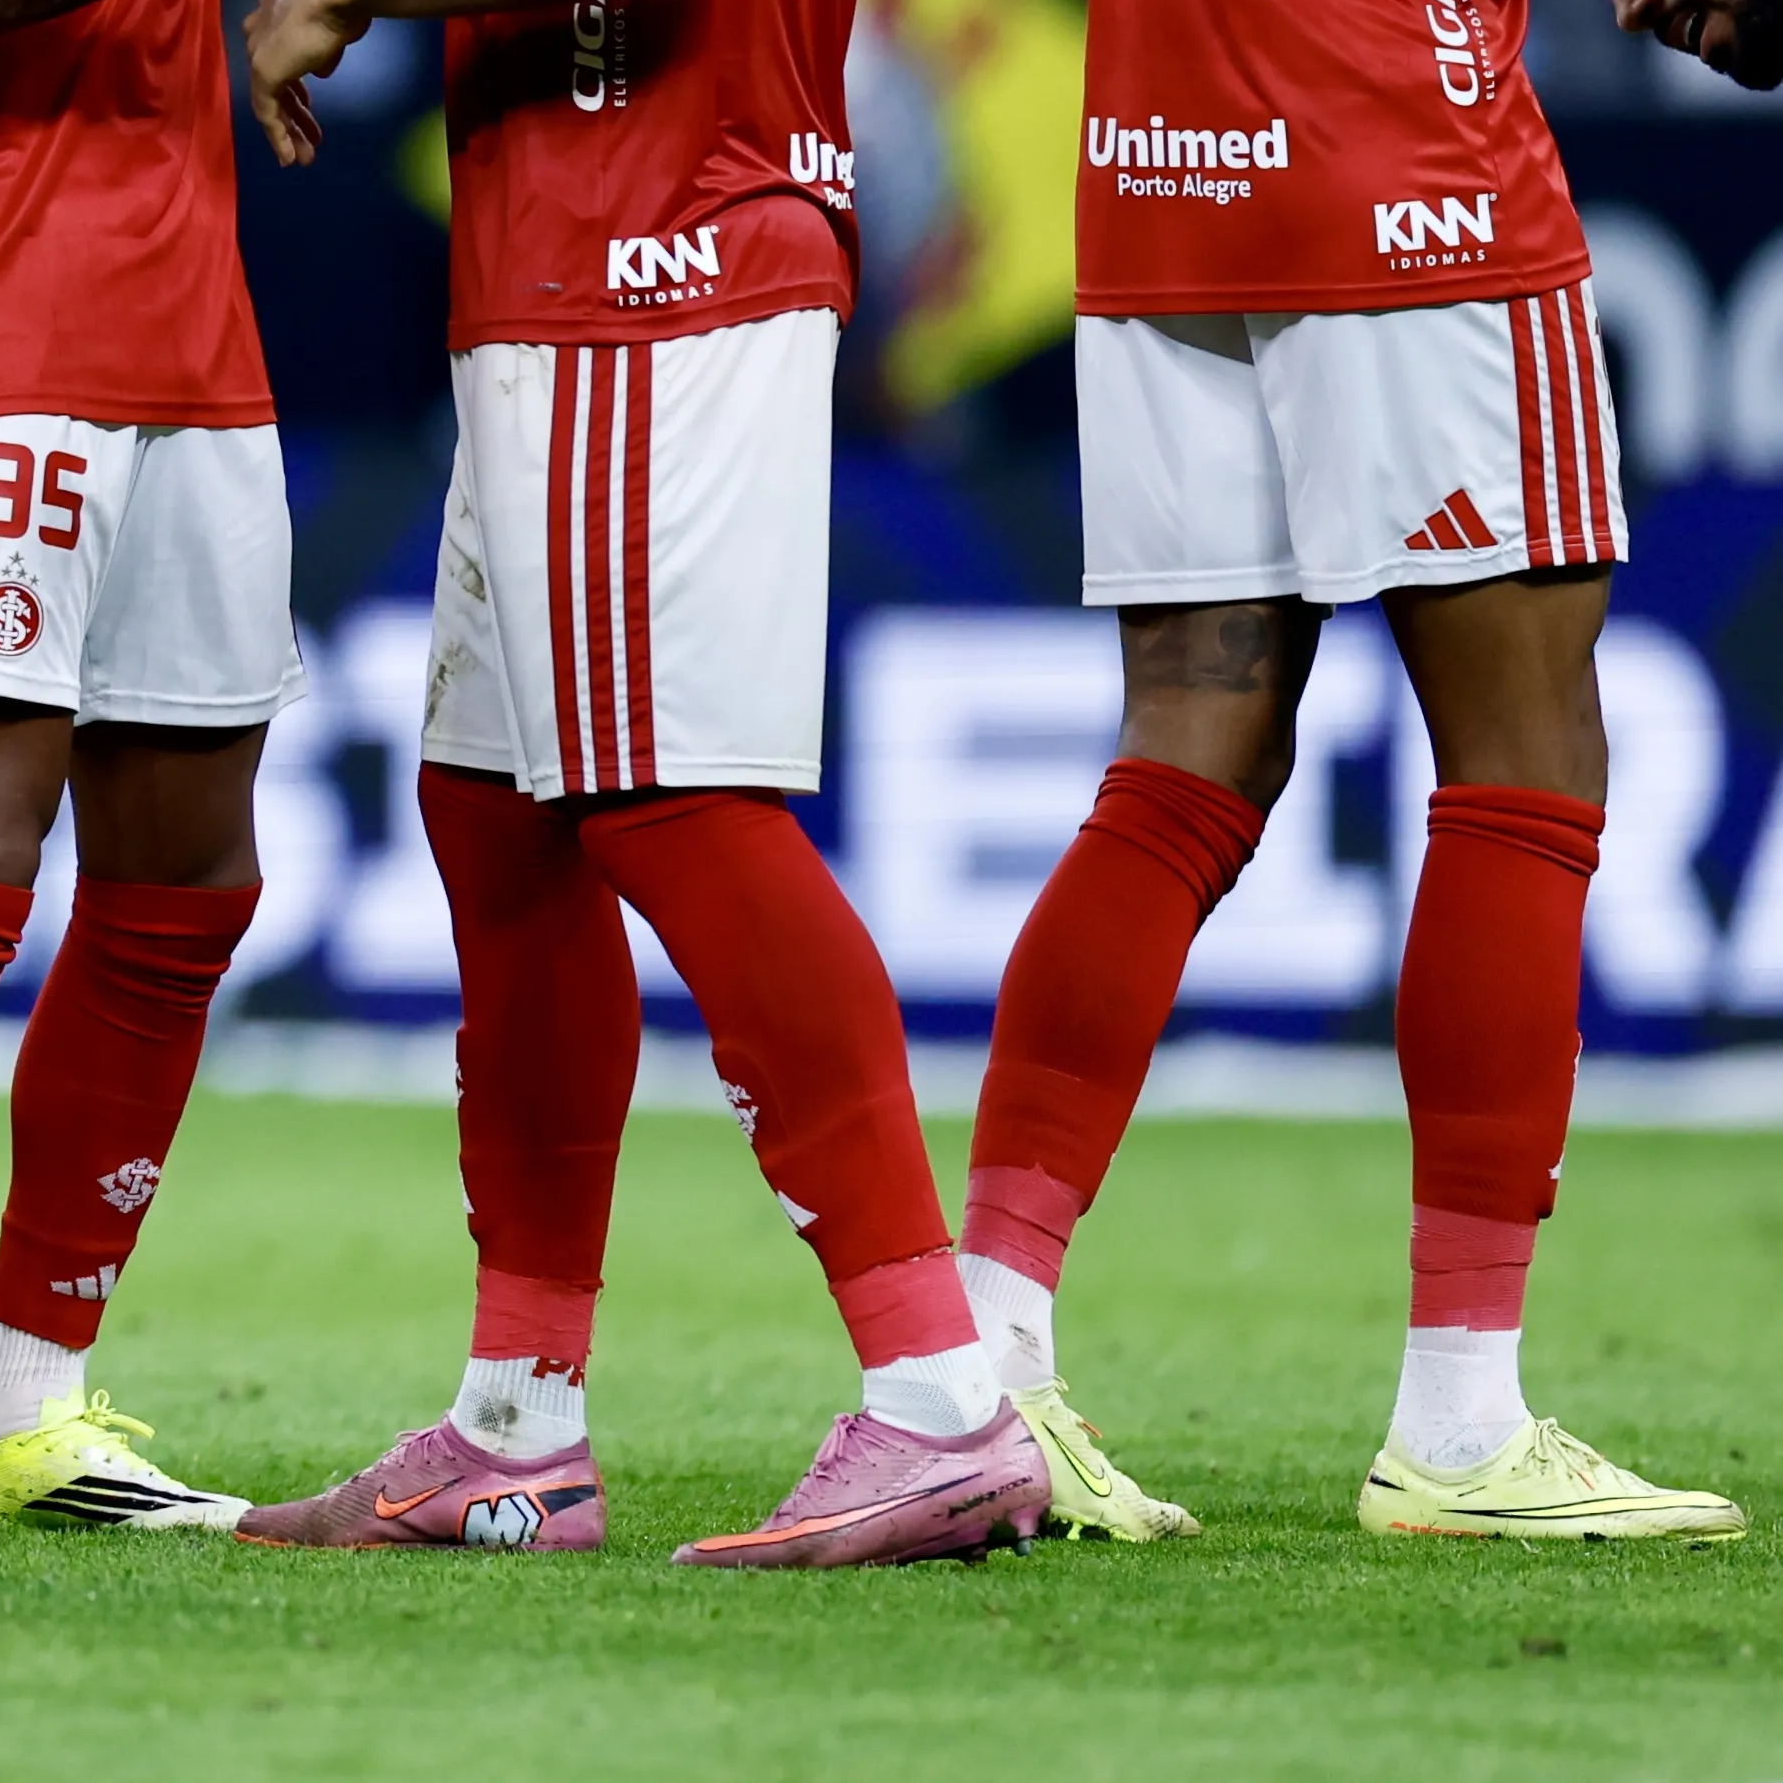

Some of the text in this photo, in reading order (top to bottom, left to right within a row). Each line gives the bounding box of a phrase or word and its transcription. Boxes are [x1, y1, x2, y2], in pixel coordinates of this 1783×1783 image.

[1087, 115, 1290, 169] Unimed
[1117, 173, 1252, 205] Porto Alegre
[1374, 193, 1495, 254] KNN
[607, 226, 721, 290] KNN
[1390, 249, 1486, 271] IDIOMAS
[618, 282, 714, 307] IDIOMAS
